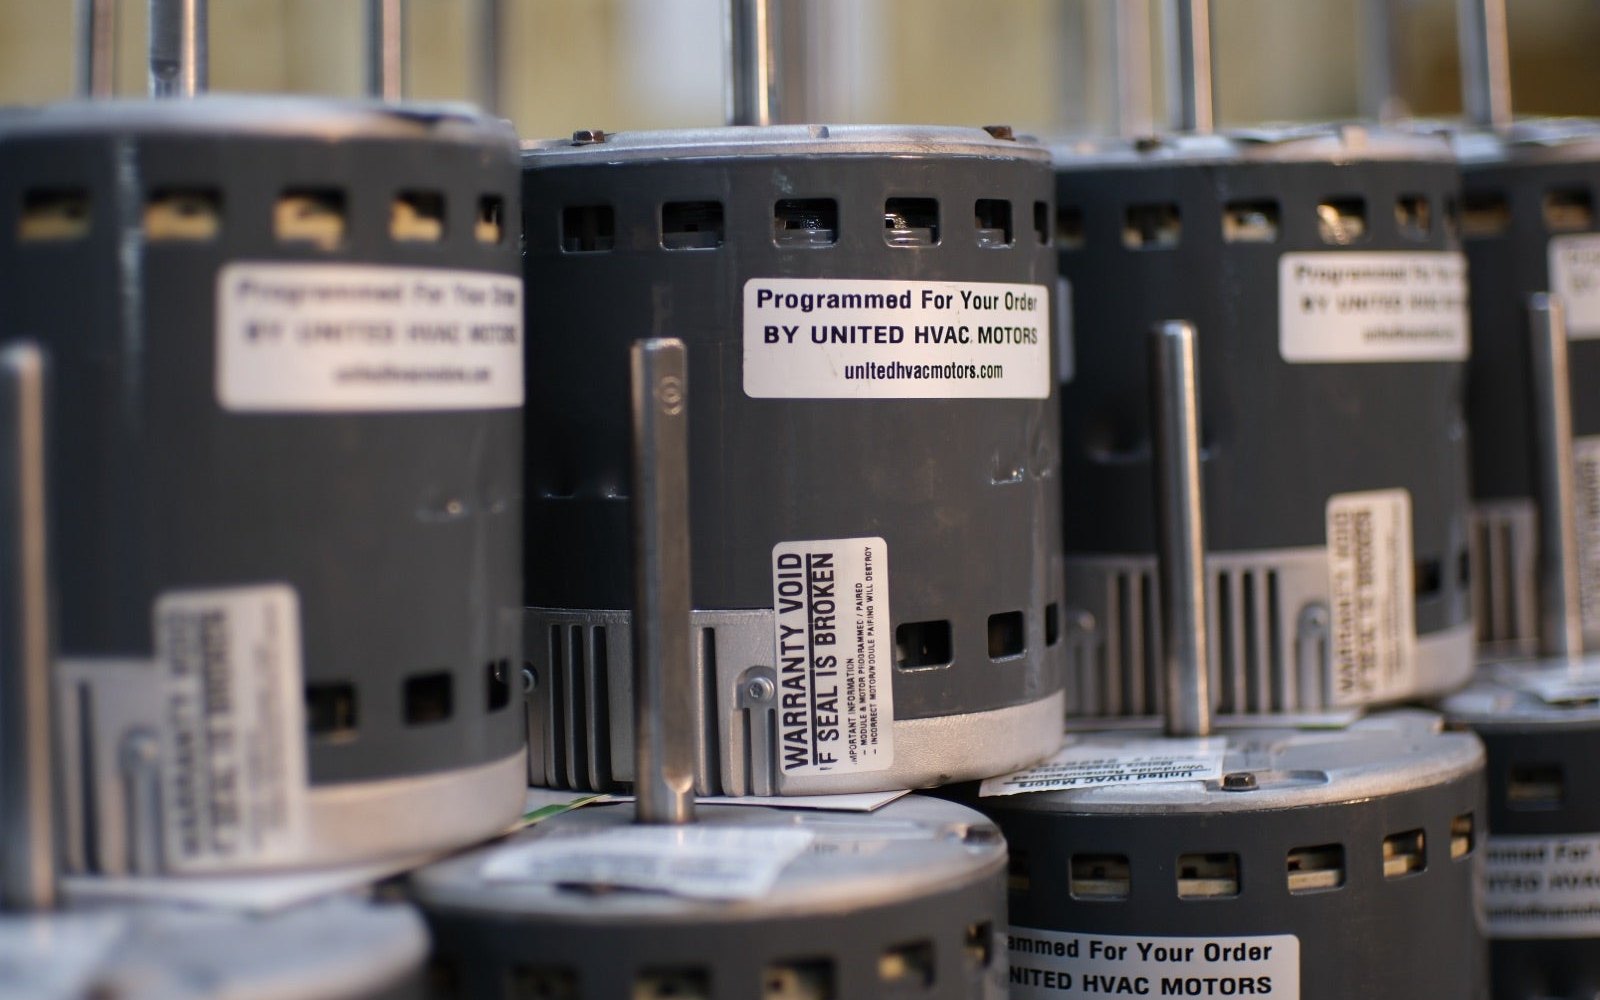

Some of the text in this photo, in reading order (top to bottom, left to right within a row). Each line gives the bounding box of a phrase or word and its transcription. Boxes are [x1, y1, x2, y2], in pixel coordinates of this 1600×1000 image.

[756, 288, 1037, 312] Programmed For Your Order
[763, 325, 1038, 346] BY UNITED HVAC MOTORS
[844, 361, 1003, 380] unitedhvacmotors.com
[864, 546, 873, 582] DESTROY
[812, 552, 837, 646] BROKEN
[855, 582, 864, 612] PAIRED
[865, 584, 874, 604] WILL
[777, 553, 809, 771] WARRANTY VOID
[815, 655, 838, 677] IS
[846, 658, 857, 715] INFORMATION
[859, 676, 867, 704] MOTOR
[816, 685, 840, 742] SEAL
[869, 703, 878, 745] INCORRECT
[860, 714, 869, 746] MODULE
[1018, 778, 1077, 788] Motors
[1083, 774, 1130, 785] HVAC
[1008, 935, 1273, 963] ammed For Your Order
[1009, 966, 1272, 996] NITED HVAC MOTORS
